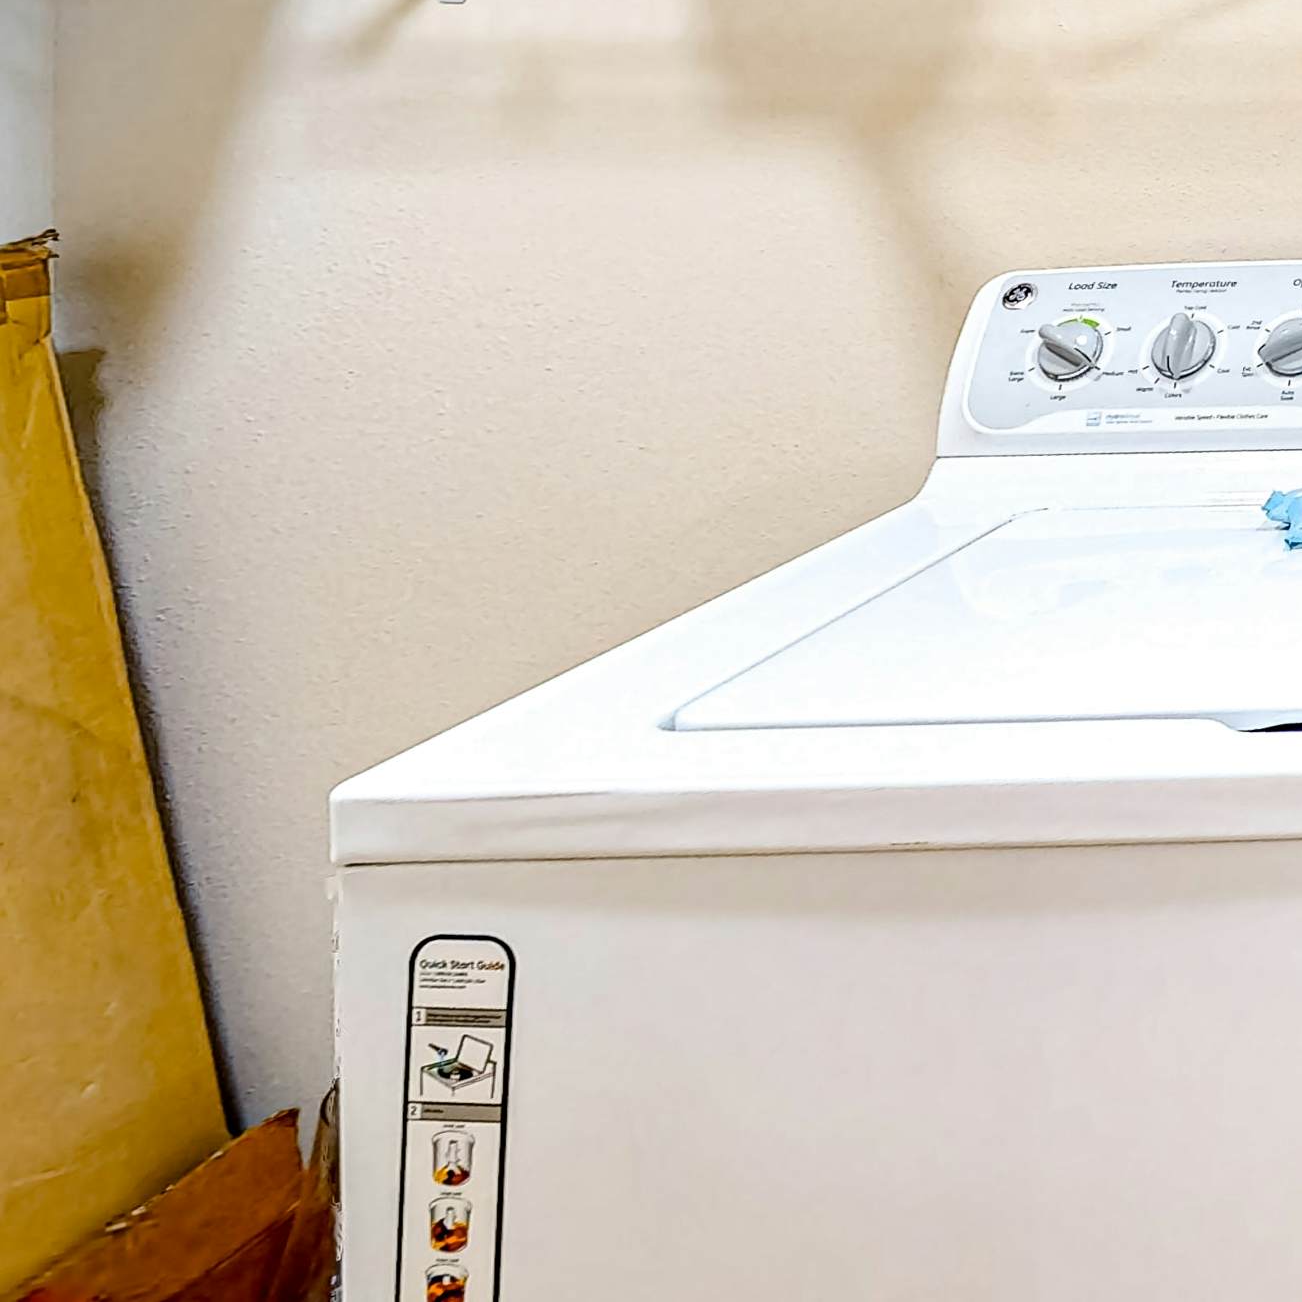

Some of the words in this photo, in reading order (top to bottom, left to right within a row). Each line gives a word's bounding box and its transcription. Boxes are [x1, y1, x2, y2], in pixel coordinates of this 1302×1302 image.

[1068, 282, 1095, 290] Load
[1097, 282, 1118, 290] Size
[1171, 280, 1238, 289] Temperature
[419, 959, 448, 970] Quick
